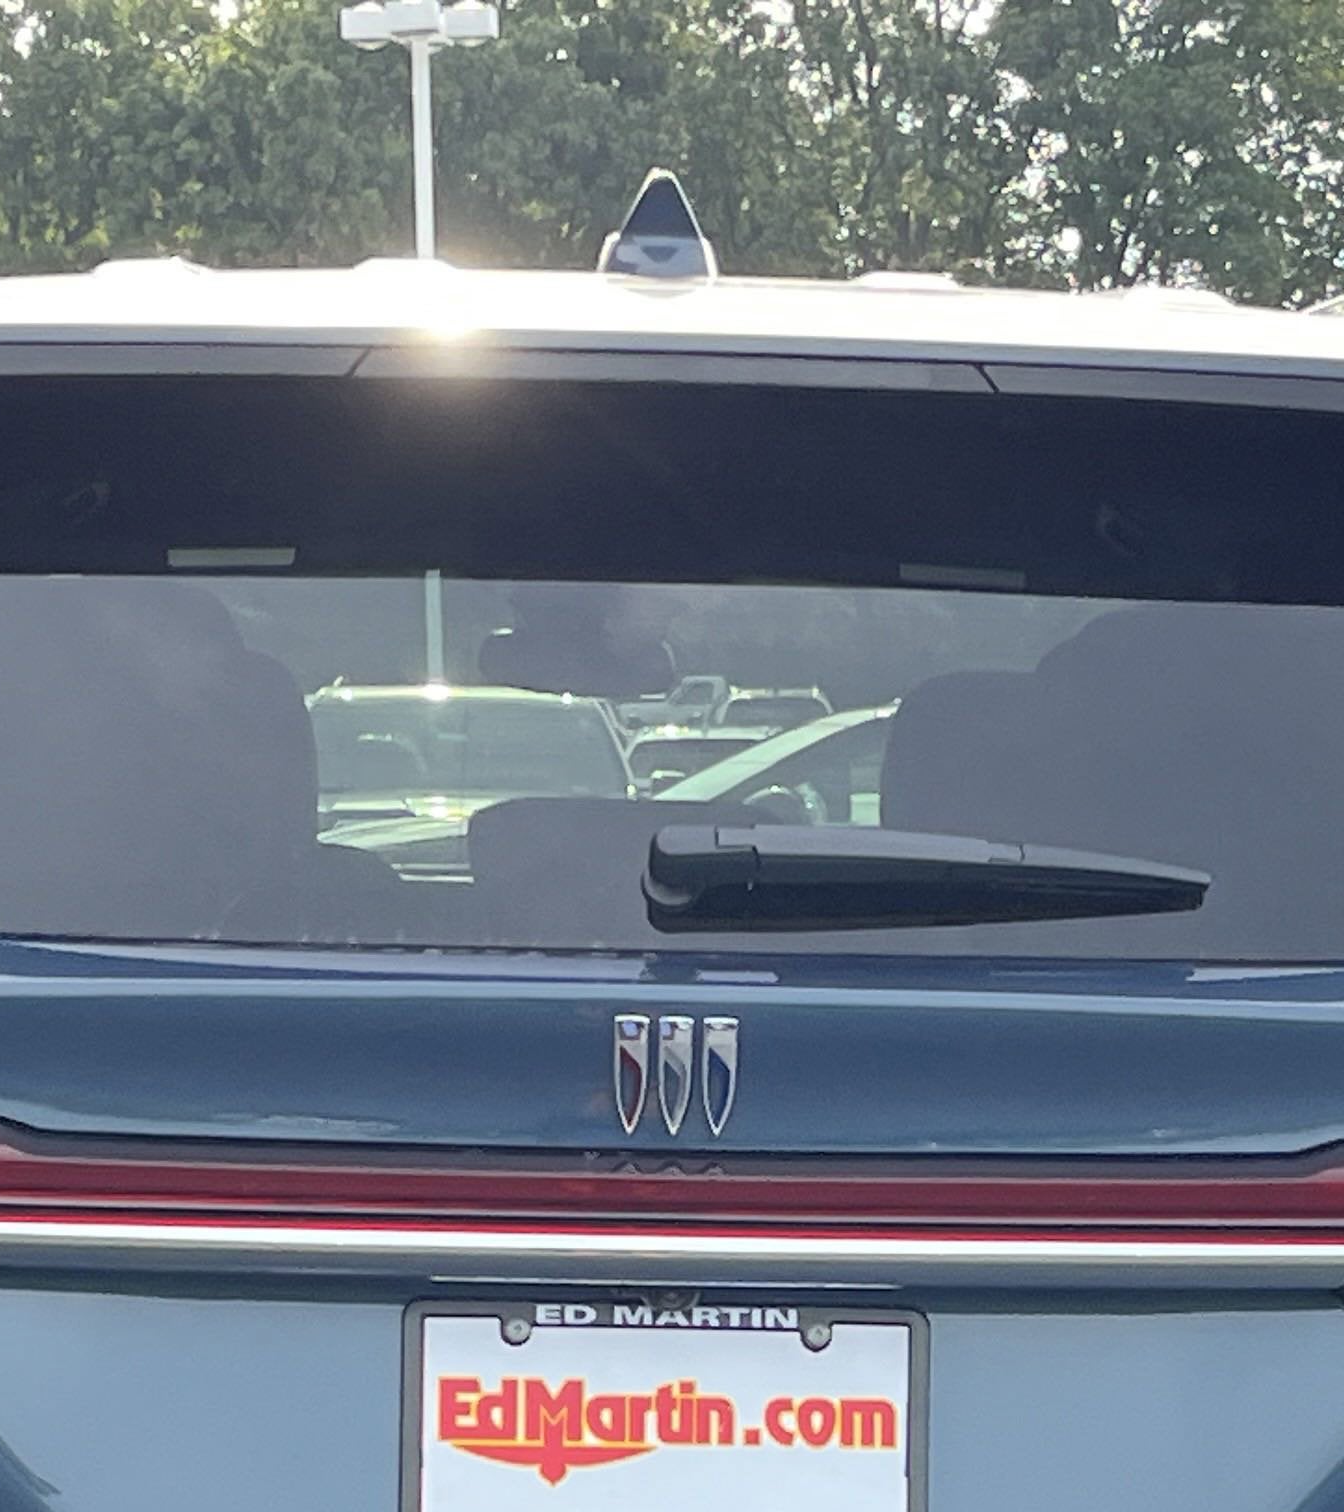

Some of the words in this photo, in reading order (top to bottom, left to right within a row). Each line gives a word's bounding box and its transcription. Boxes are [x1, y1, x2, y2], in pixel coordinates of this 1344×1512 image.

[536, 1303, 599, 1326] ED
[613, 1305, 799, 1329] MARTIN
[438, 1378, 897, 1447] EdMartin.com
